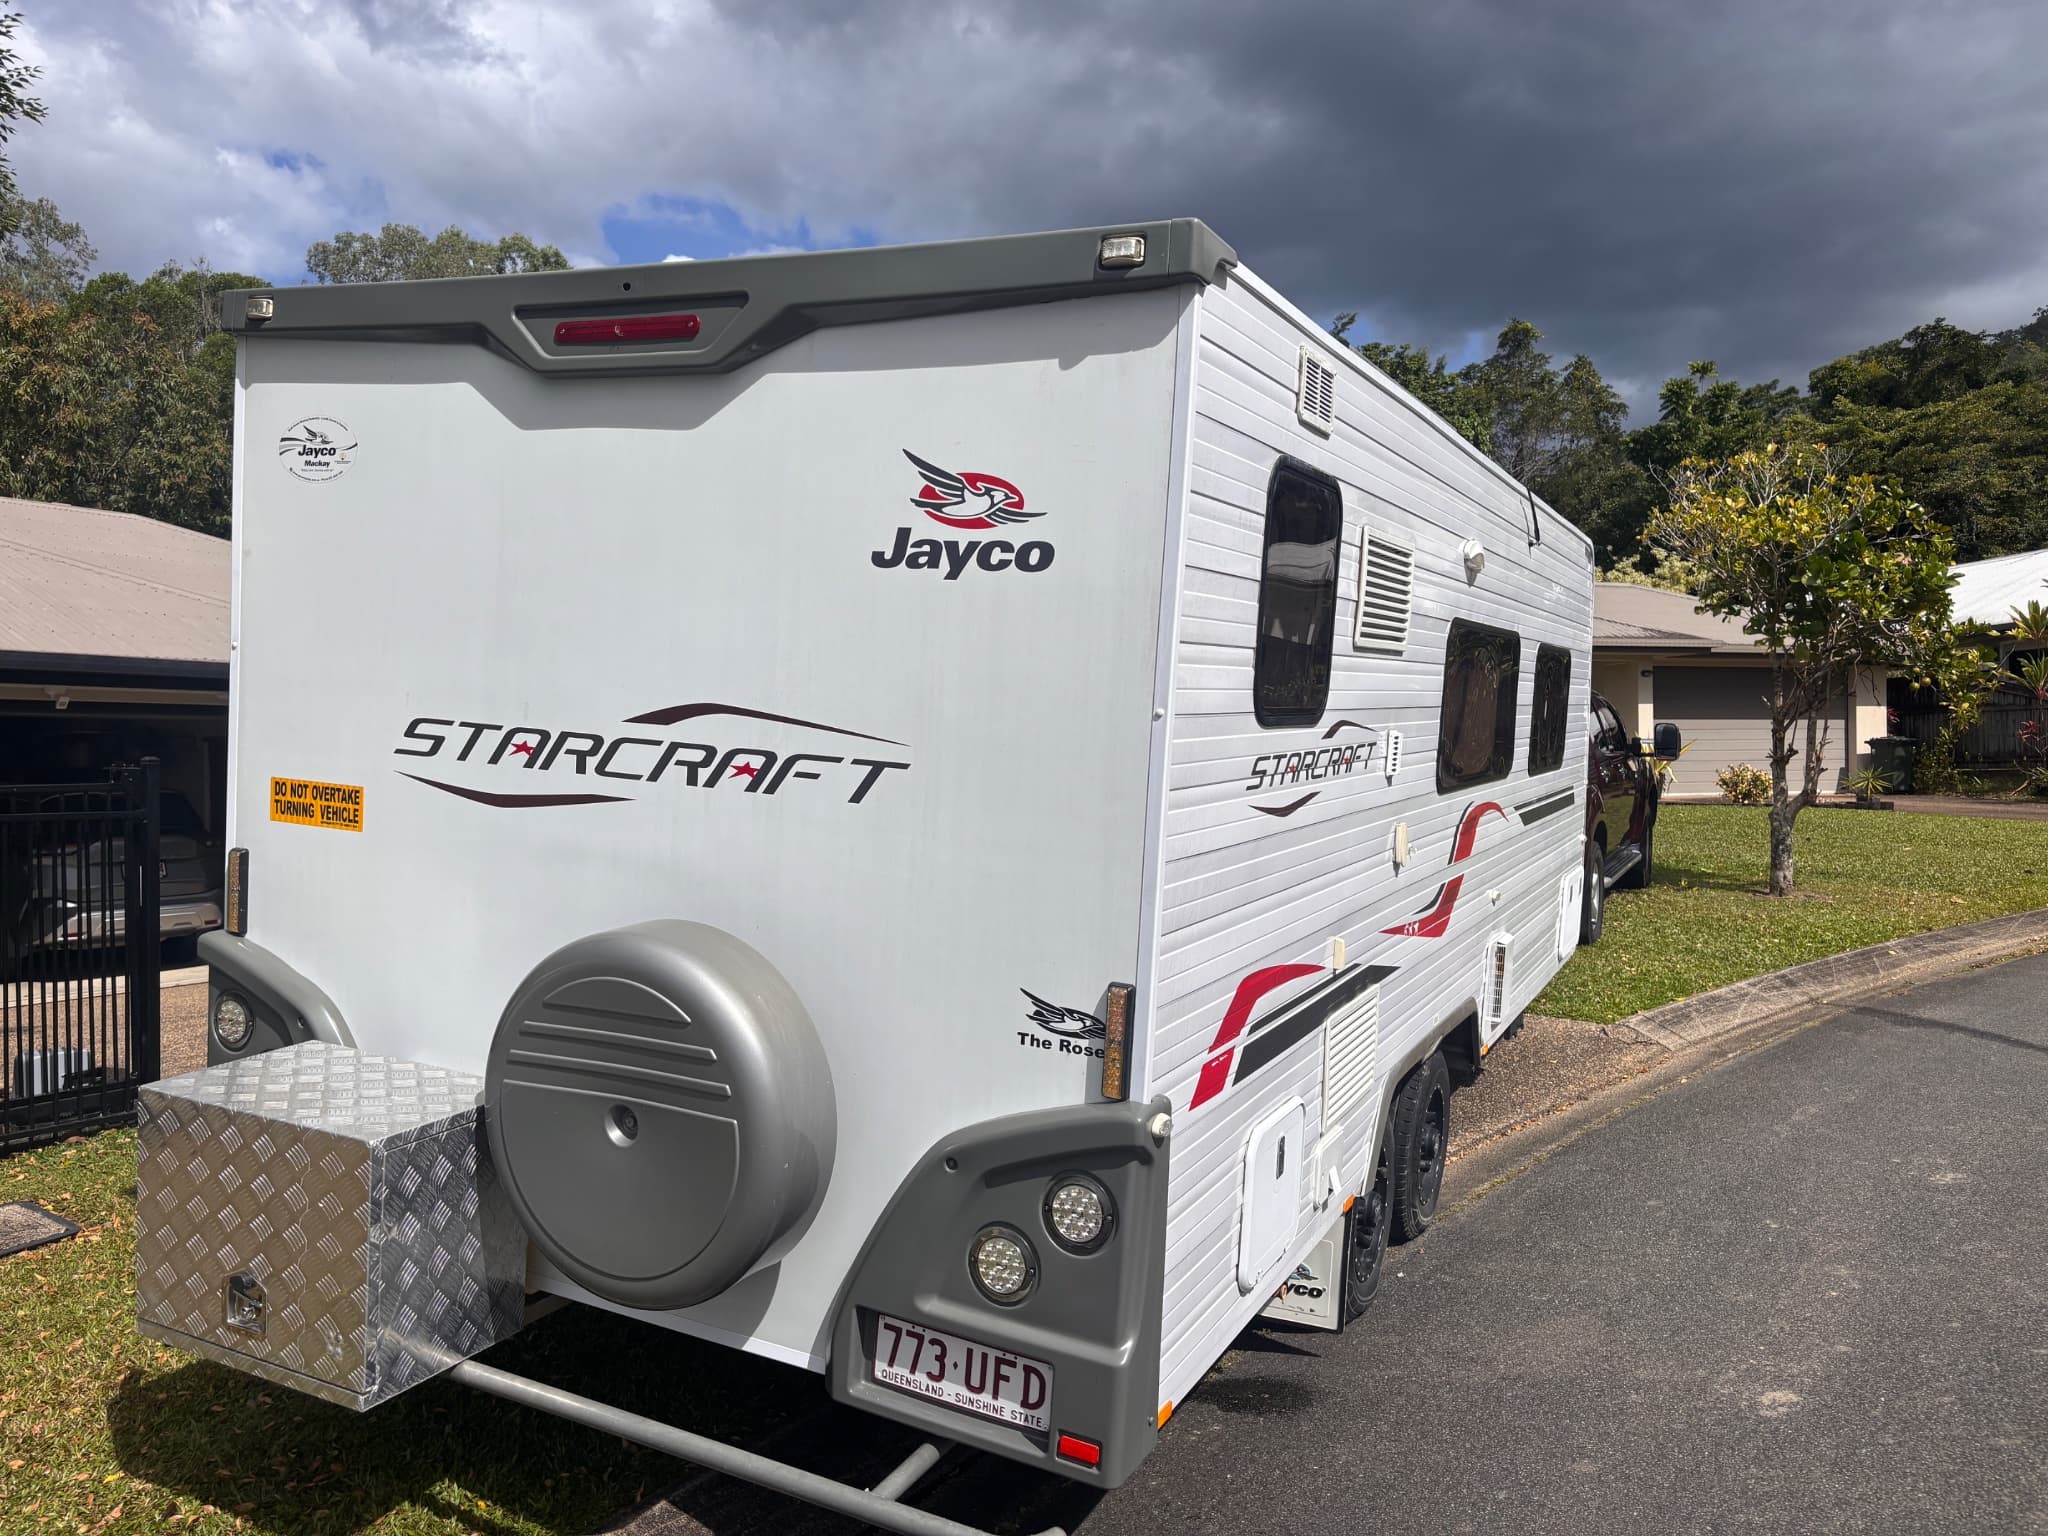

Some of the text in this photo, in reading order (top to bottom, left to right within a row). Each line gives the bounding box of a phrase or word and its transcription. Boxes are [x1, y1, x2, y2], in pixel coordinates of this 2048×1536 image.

[298, 444, 337, 459] Jayco
[304, 460, 331, 468] Mackay
[871, 527, 1056, 581] Jayco
[393, 717, 911, 804] STARCRAFT
[1246, 742, 1377, 791] STARCRAFT
[274, 781, 360, 805] DO NOT OVERTAKE
[274, 799, 359, 824] TURNING VEHICLE
[1017, 1031, 1105, 1059] The Rose
[881, 1368, 944, 1398] QUEENSLAND
[955, 1392, 1006, 1418] SUNSHINE
[1010, 1409, 1043, 1429] STATE
